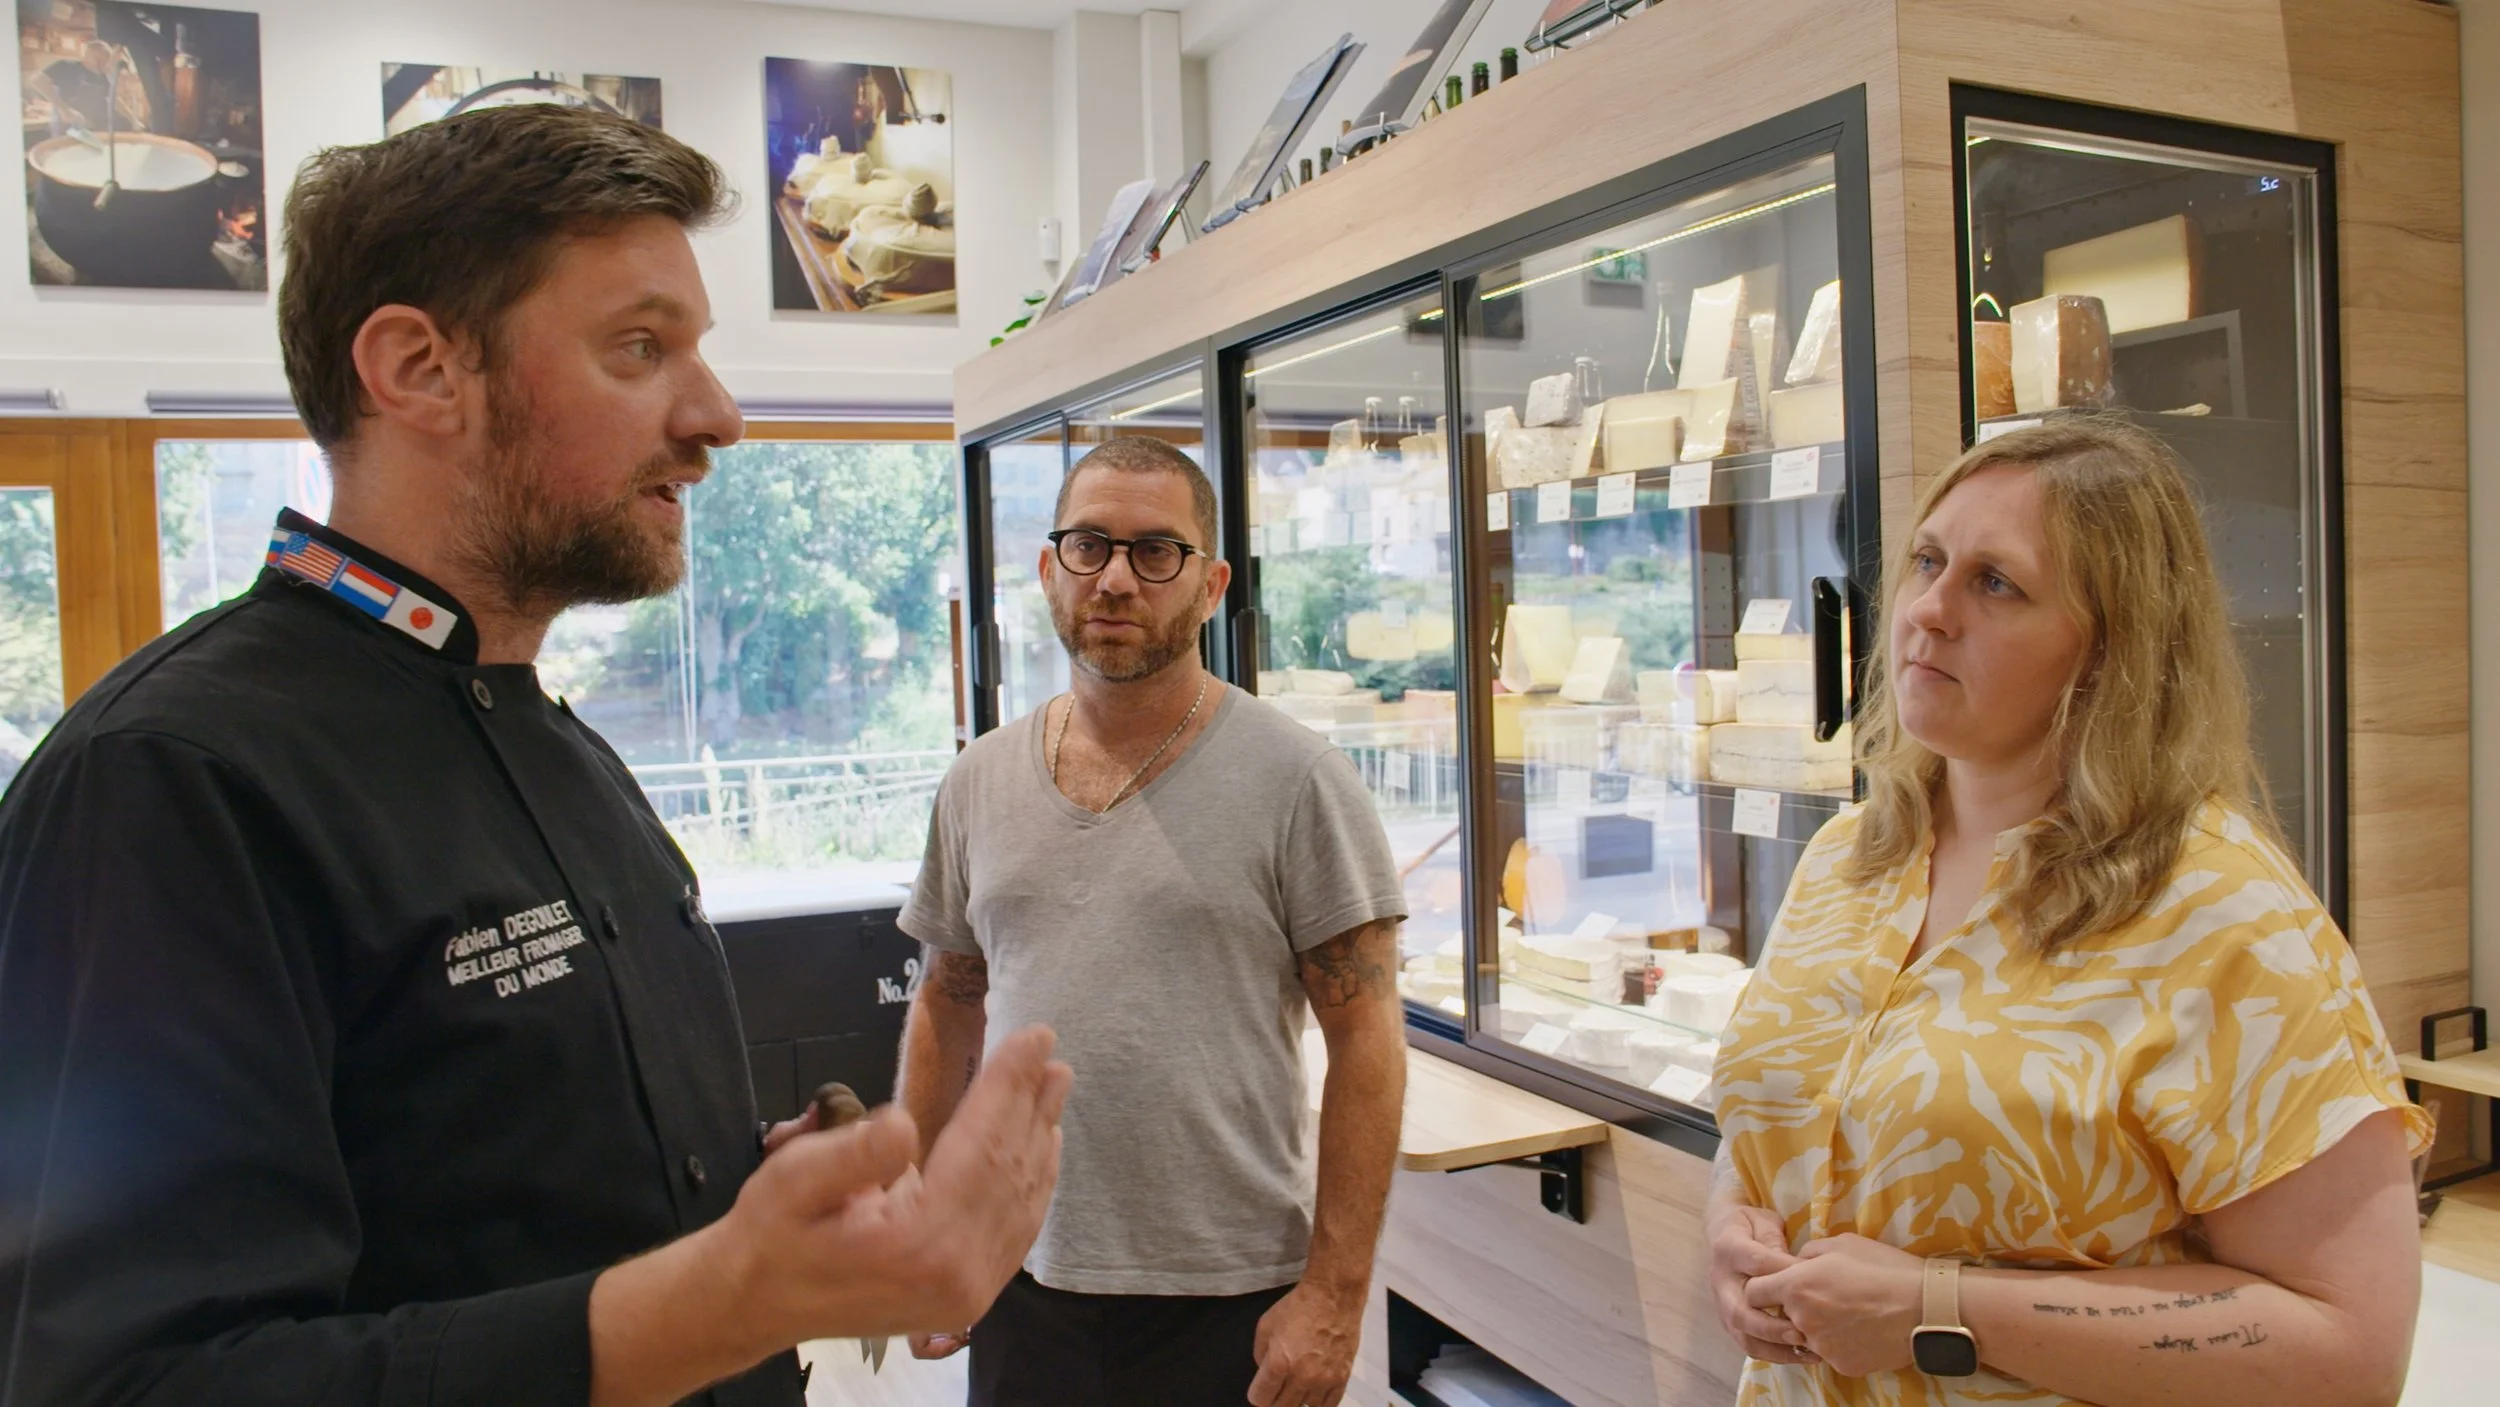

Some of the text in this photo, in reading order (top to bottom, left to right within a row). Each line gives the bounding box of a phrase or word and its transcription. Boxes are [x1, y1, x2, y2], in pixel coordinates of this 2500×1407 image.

[444, 899, 574, 962] Fabien DEGOULET
[447, 925, 586, 986] MEILLEUR FROMAGER
[494, 955, 574, 998] DU MONDE
